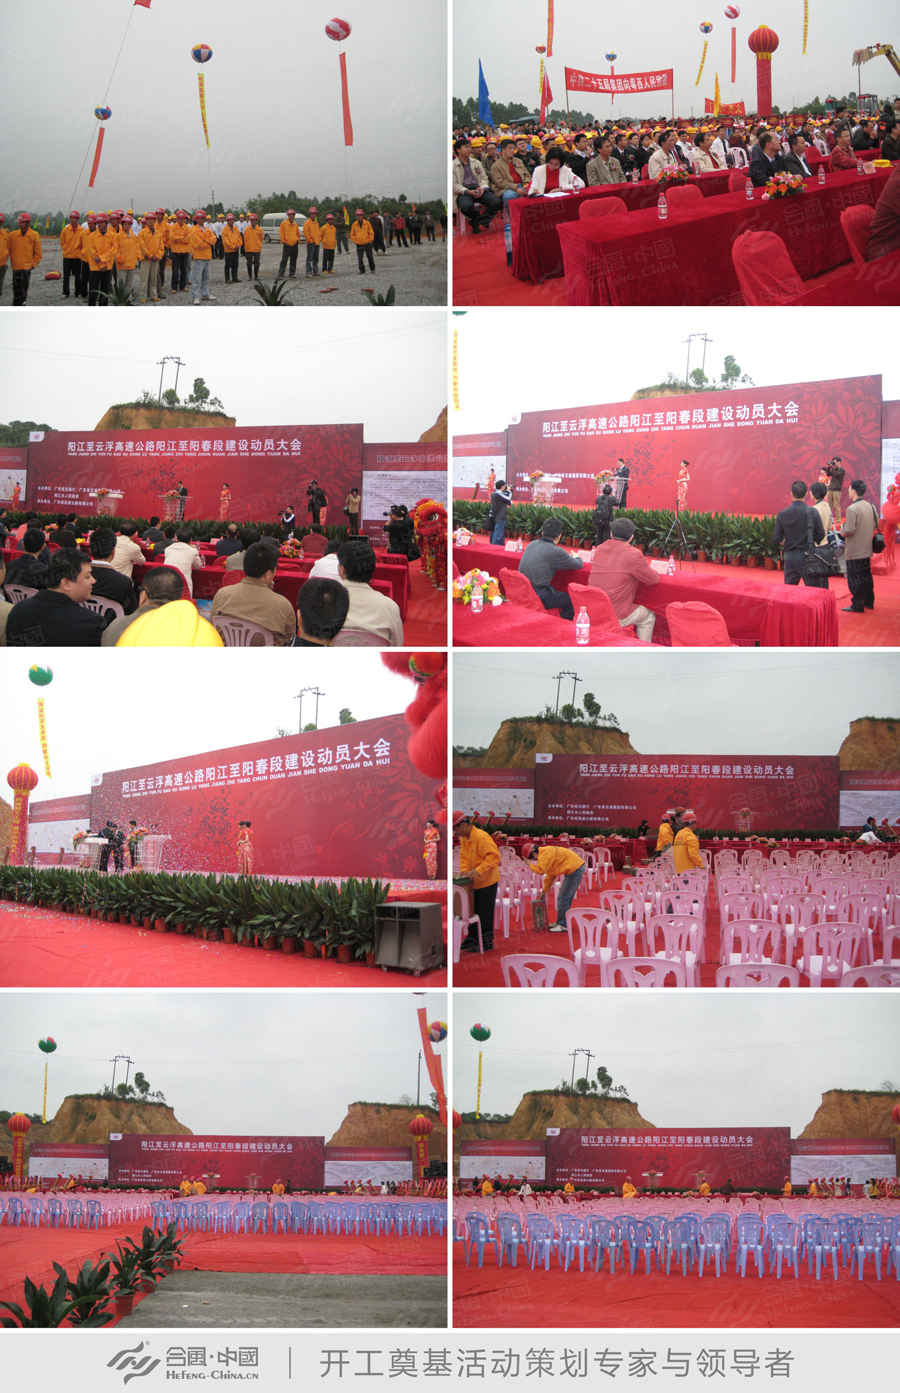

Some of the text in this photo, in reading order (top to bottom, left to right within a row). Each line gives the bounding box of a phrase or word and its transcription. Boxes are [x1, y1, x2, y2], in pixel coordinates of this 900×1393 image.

[543, 400, 799, 432] 阳江至云浮高速公路阳江至阳春段建设动员大会
[68, 438, 302, 452] 阳江至云浮高速公路阳江至阳春段建设动员大会
[122, 738, 391, 792] 阳江至云浮高速公路阳江至阳春段建设动员大会
[340, 762, 360, 770] YUAN
[580, 764, 794, 774] 阳江至云浮高速公路阳江至阳春段建设动员大会
[142, 1136, 293, 1145] 阳江至云浮高速公路阳江至阳春段建设动员大会
[581, 1136, 754, 1144] 阳江至云浮高速公路阳江至阳春段建设动员大会
